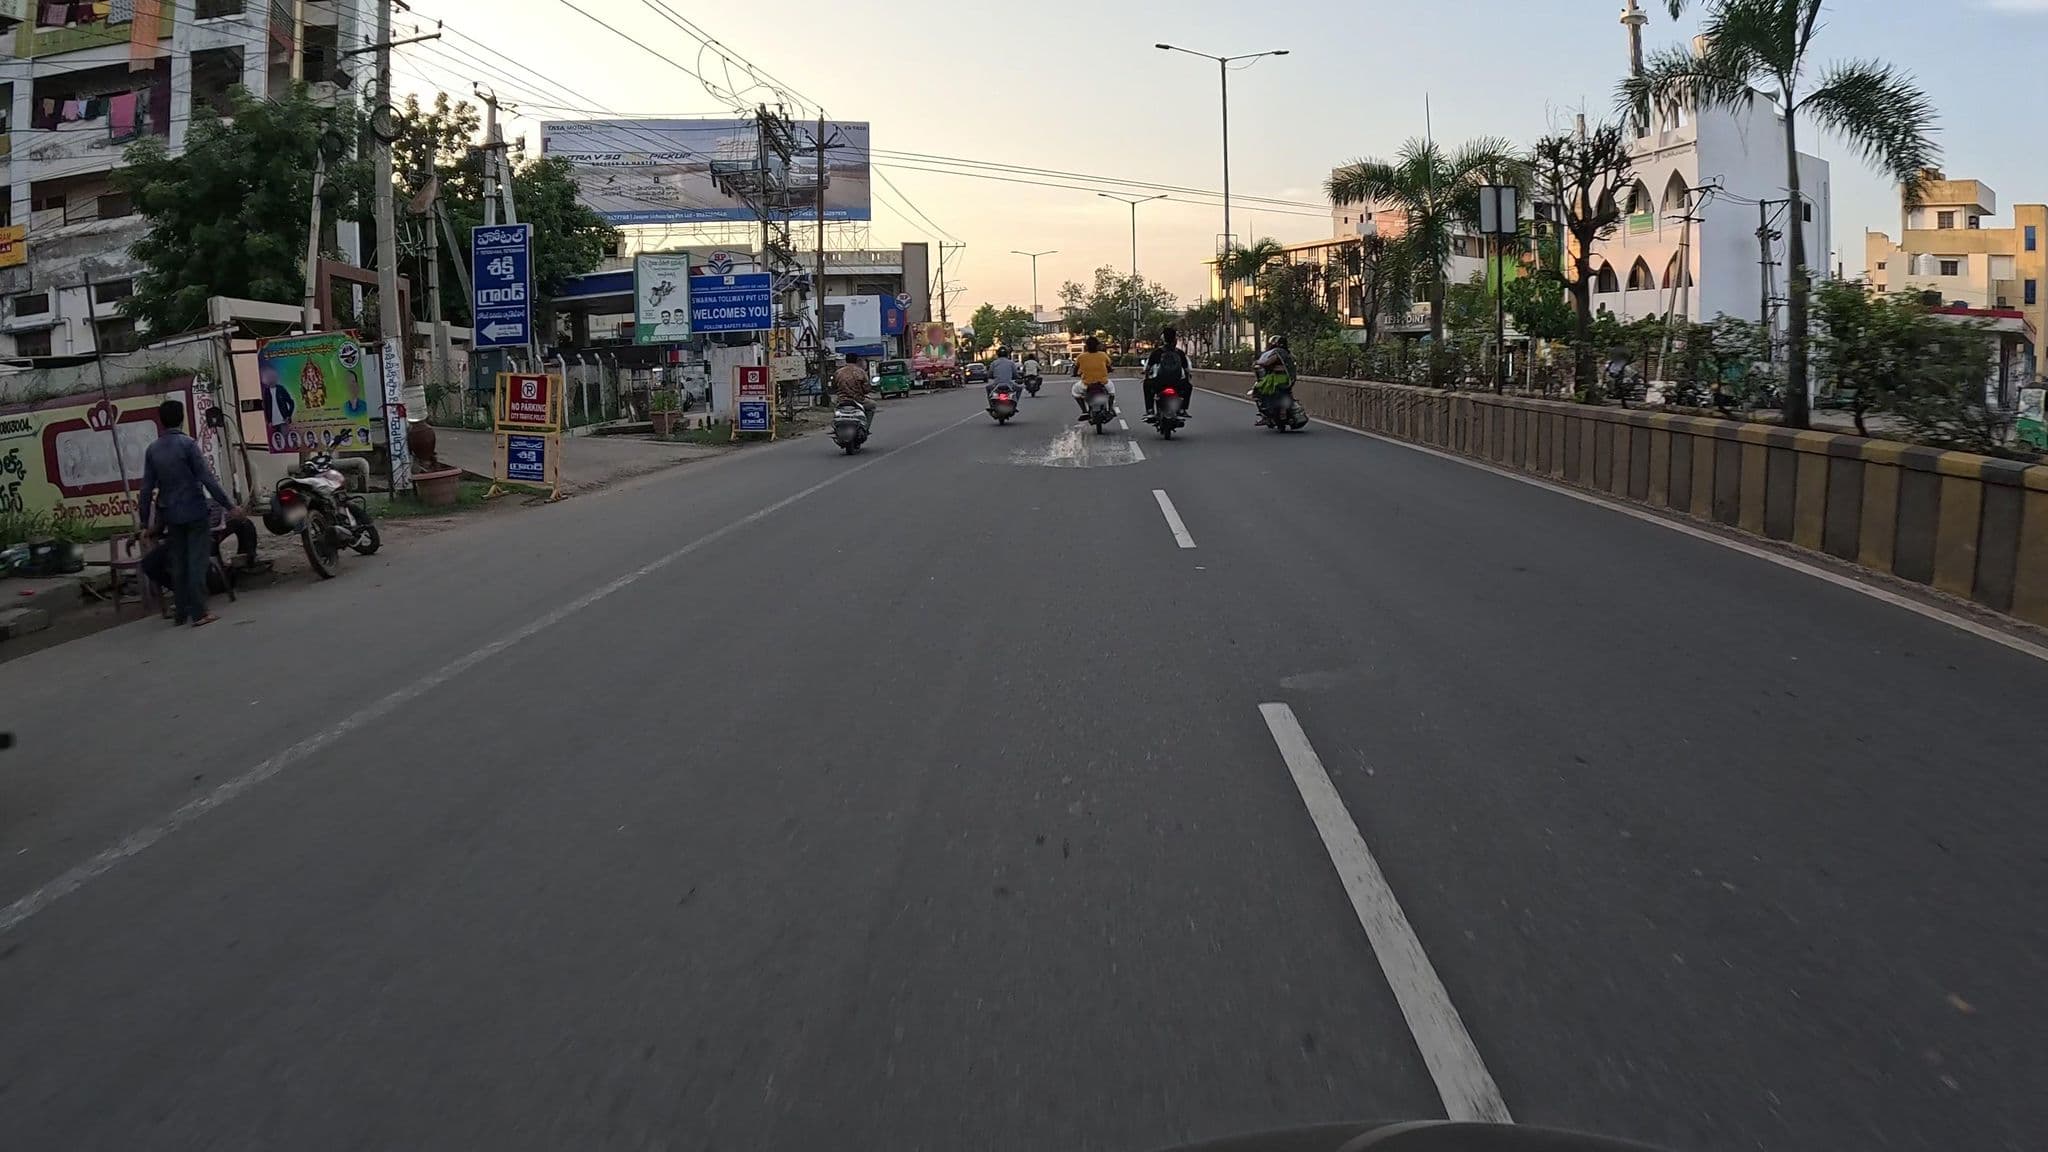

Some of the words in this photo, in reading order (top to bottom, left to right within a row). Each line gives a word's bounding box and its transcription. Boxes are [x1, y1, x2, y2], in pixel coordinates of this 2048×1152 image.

[477, 228, 525, 245] హోటల్
[487, 256, 515, 280] శక్తి
[477, 282, 525, 306] గ్రాండ్
[692, 296, 718, 304] SWARNA
[718, 295, 745, 303] TOLLWAY
[746, 294, 757, 302] PVT
[693, 307, 746, 320] WELCOMES
[748, 306, 768, 317] YOU
[511, 402, 519, 411] NO
